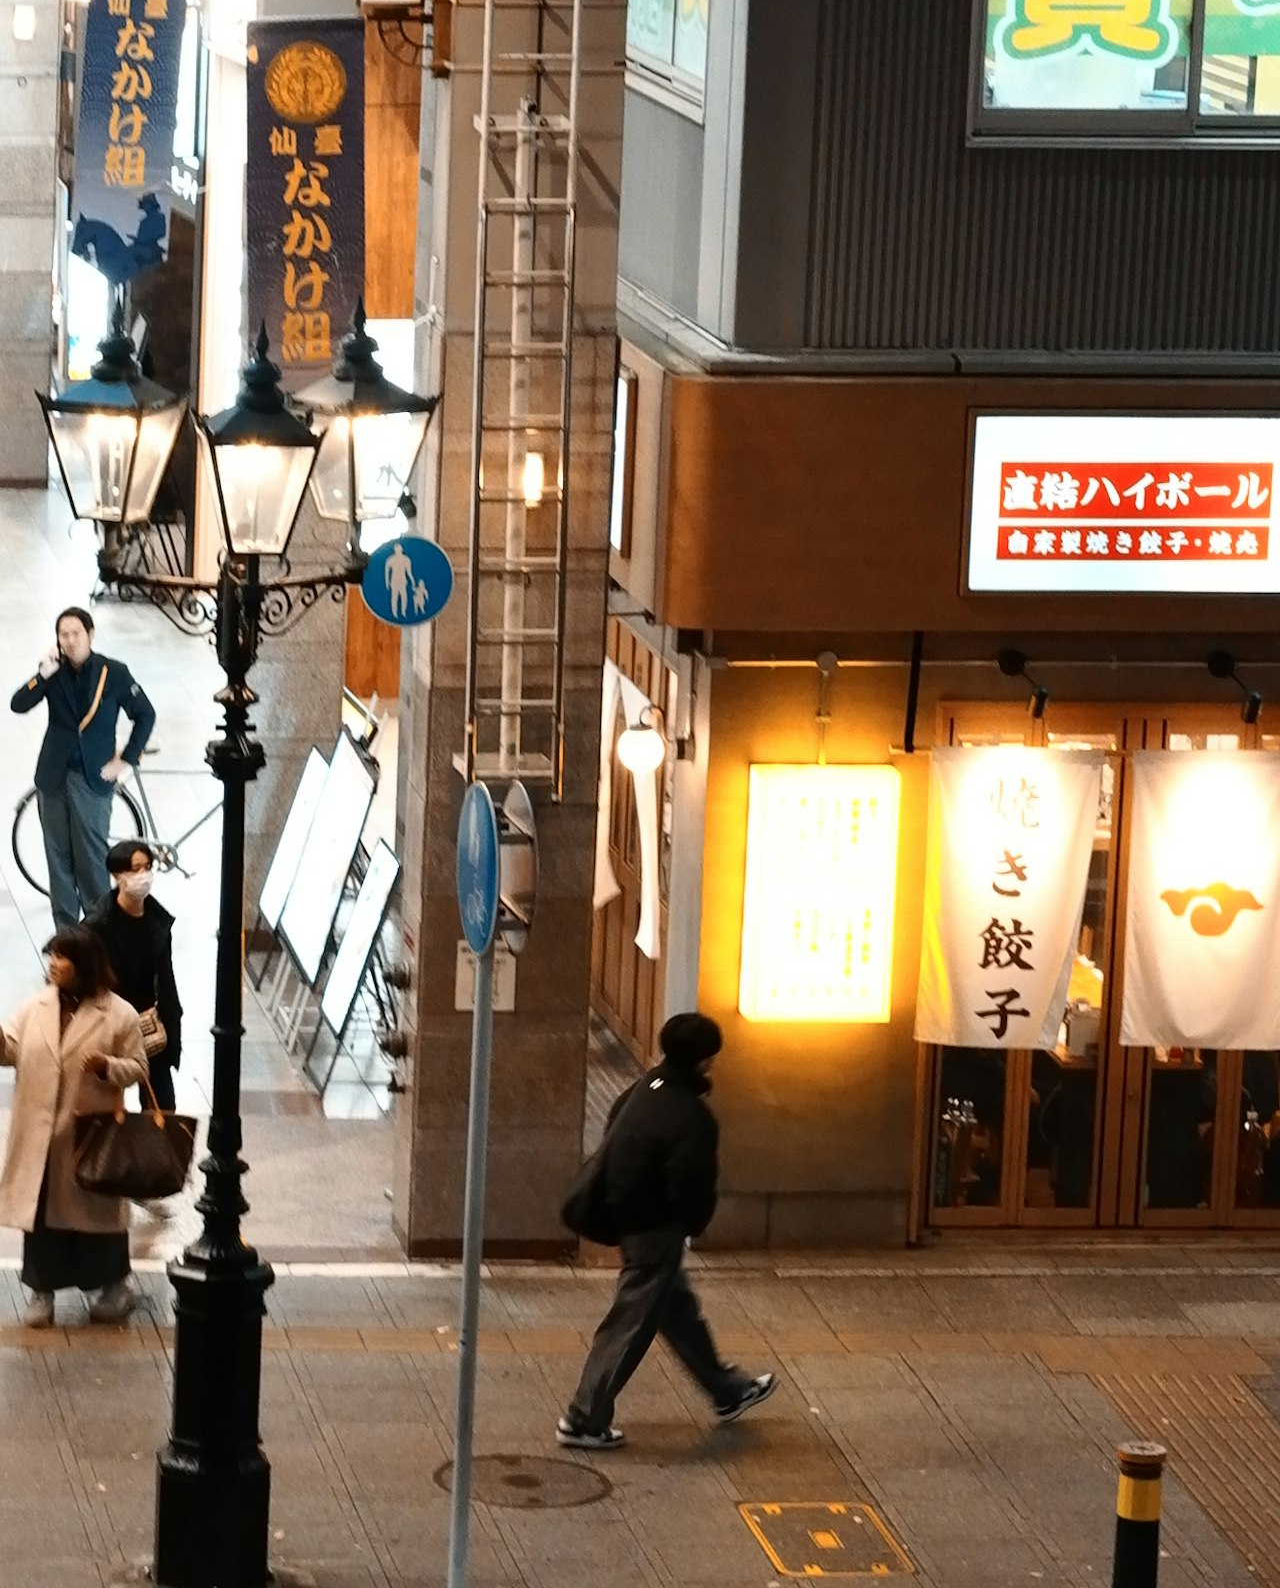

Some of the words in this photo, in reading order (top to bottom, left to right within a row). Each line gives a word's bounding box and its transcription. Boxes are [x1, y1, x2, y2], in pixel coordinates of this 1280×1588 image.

[104, 17, 154, 188] なかけ組
[282, 157, 333, 363] なかけ組
[1002, 469, 1270, 512] 直結ハイボール
[974, 777, 1037, 1041] 焼き餃子
